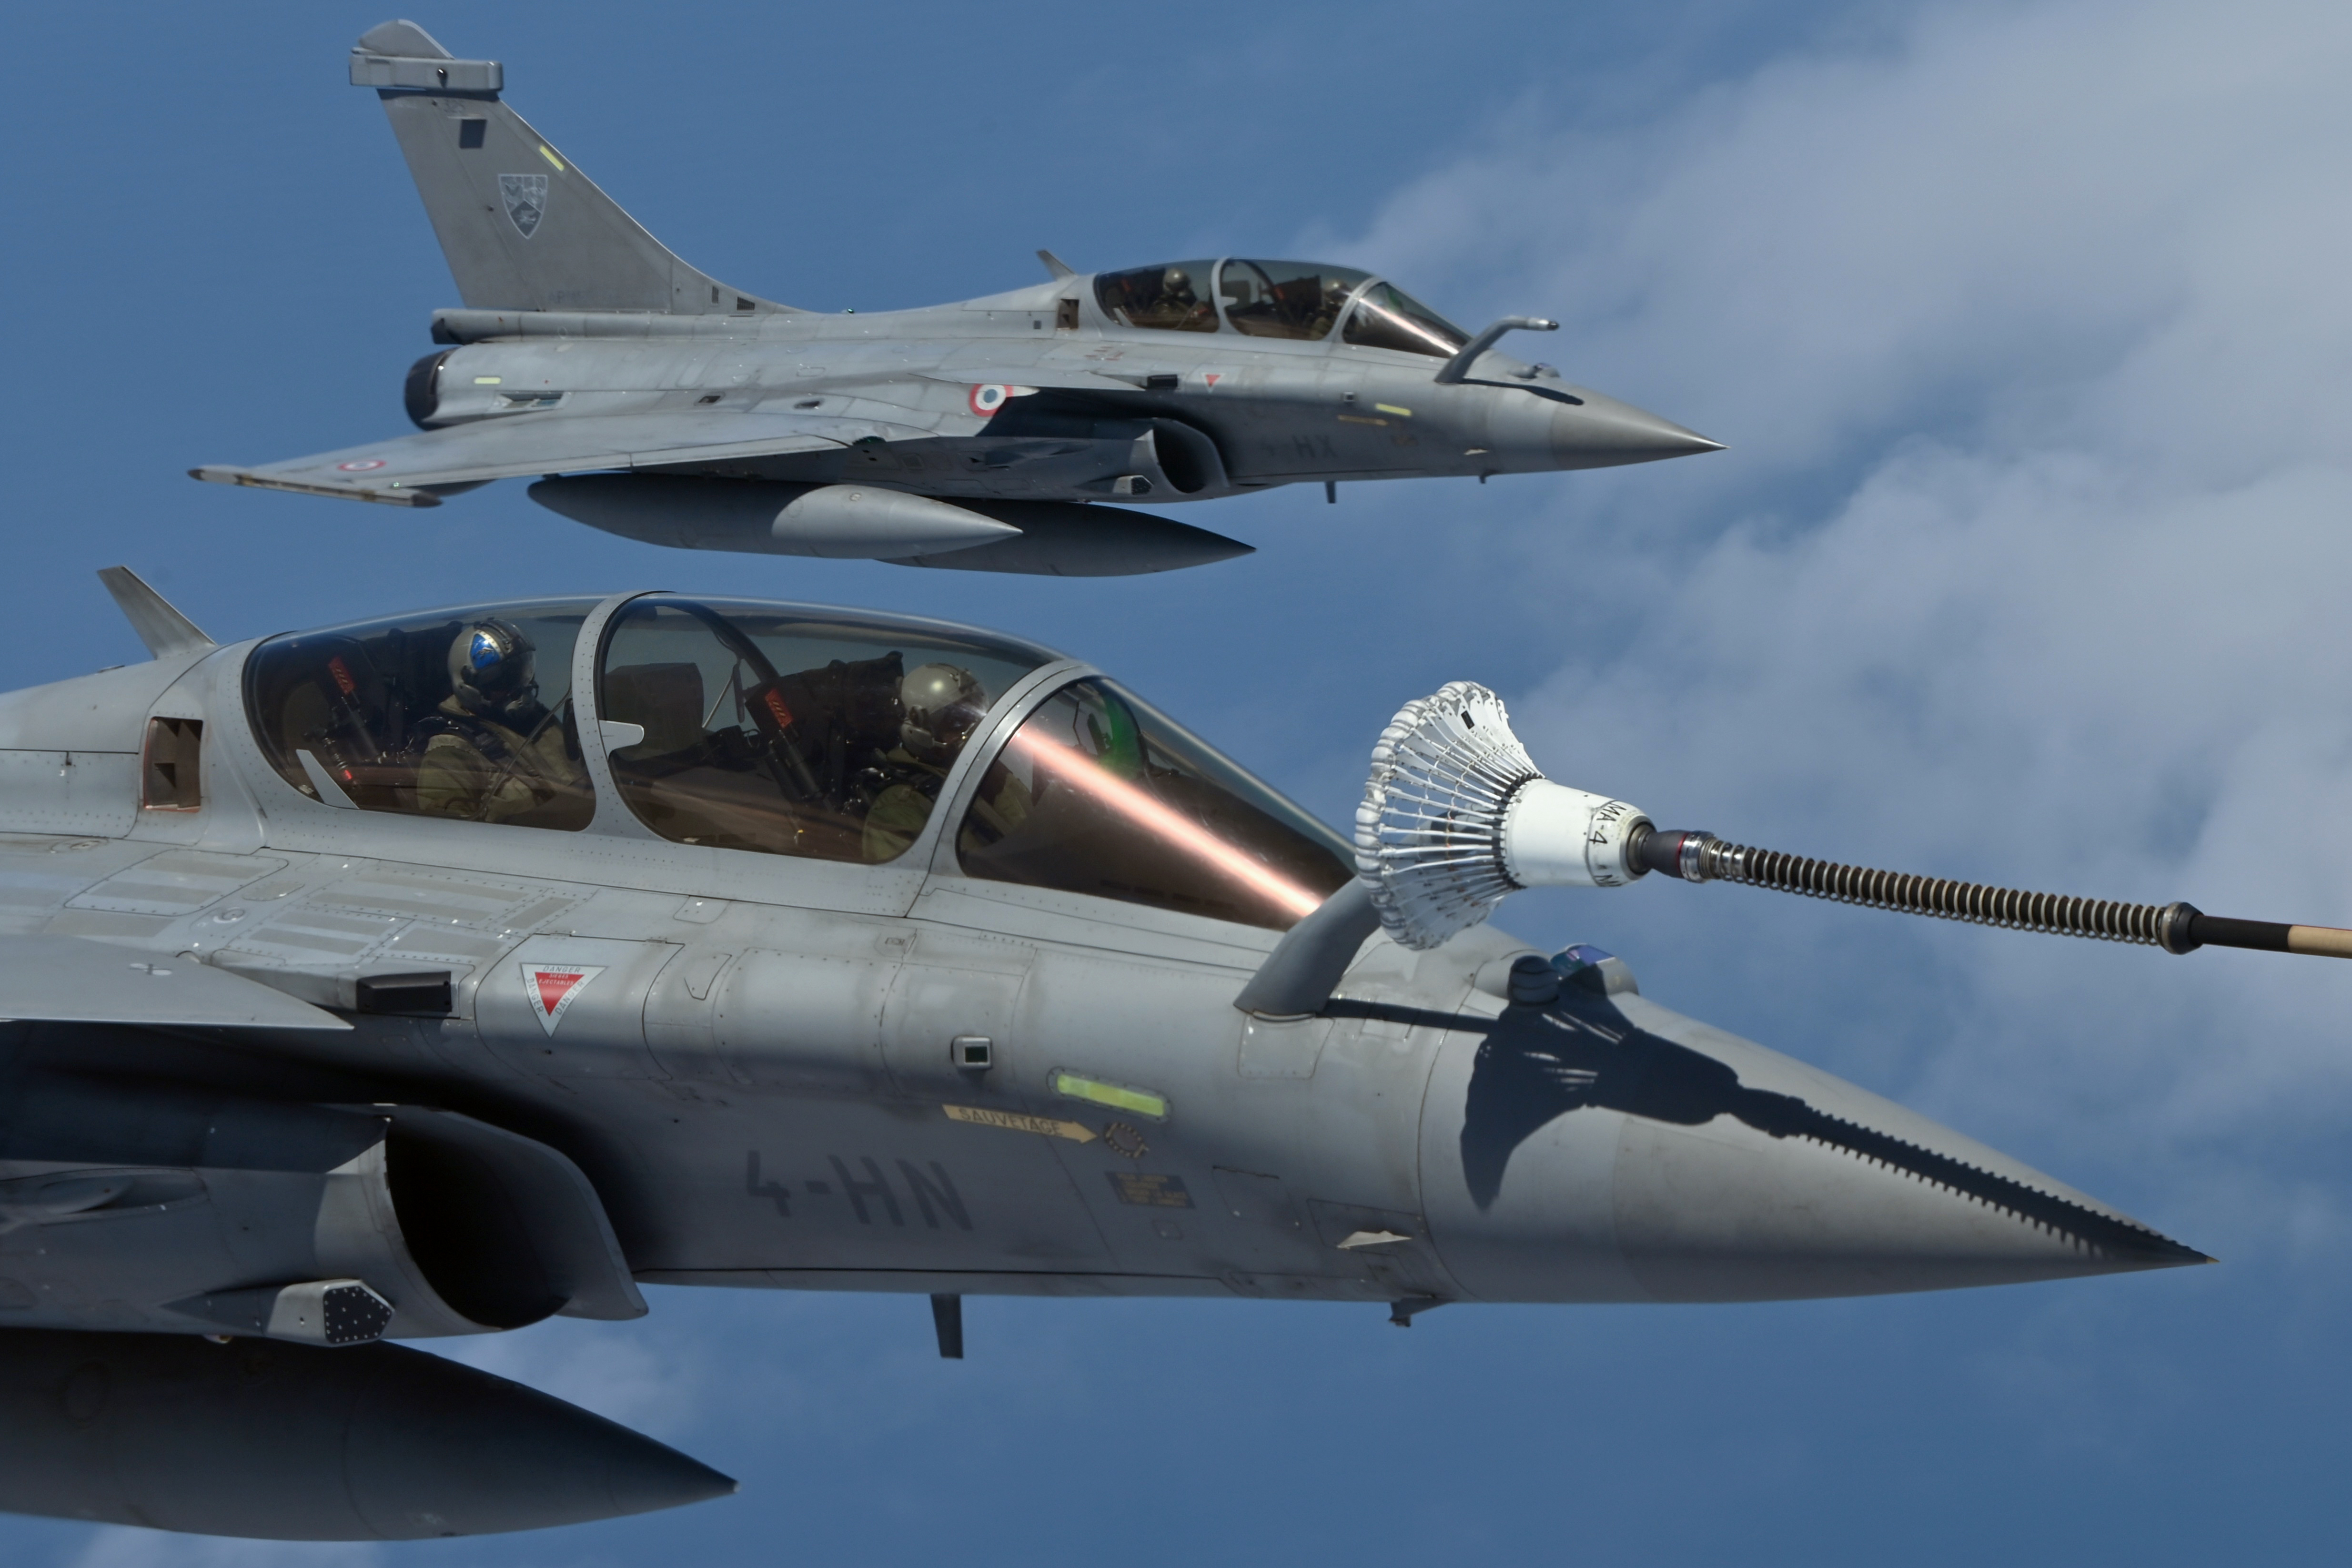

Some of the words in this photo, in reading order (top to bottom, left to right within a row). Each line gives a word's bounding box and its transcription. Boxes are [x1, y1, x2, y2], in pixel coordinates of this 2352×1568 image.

[1589, 802, 1626, 844] MA-4
[526, 978, 544, 1013] DANGER
[555, 981, 585, 1014] DANGER
[959, 1107, 1064, 1135] SAUVETAGE
[746, 1150, 974, 1231] 4-HN
